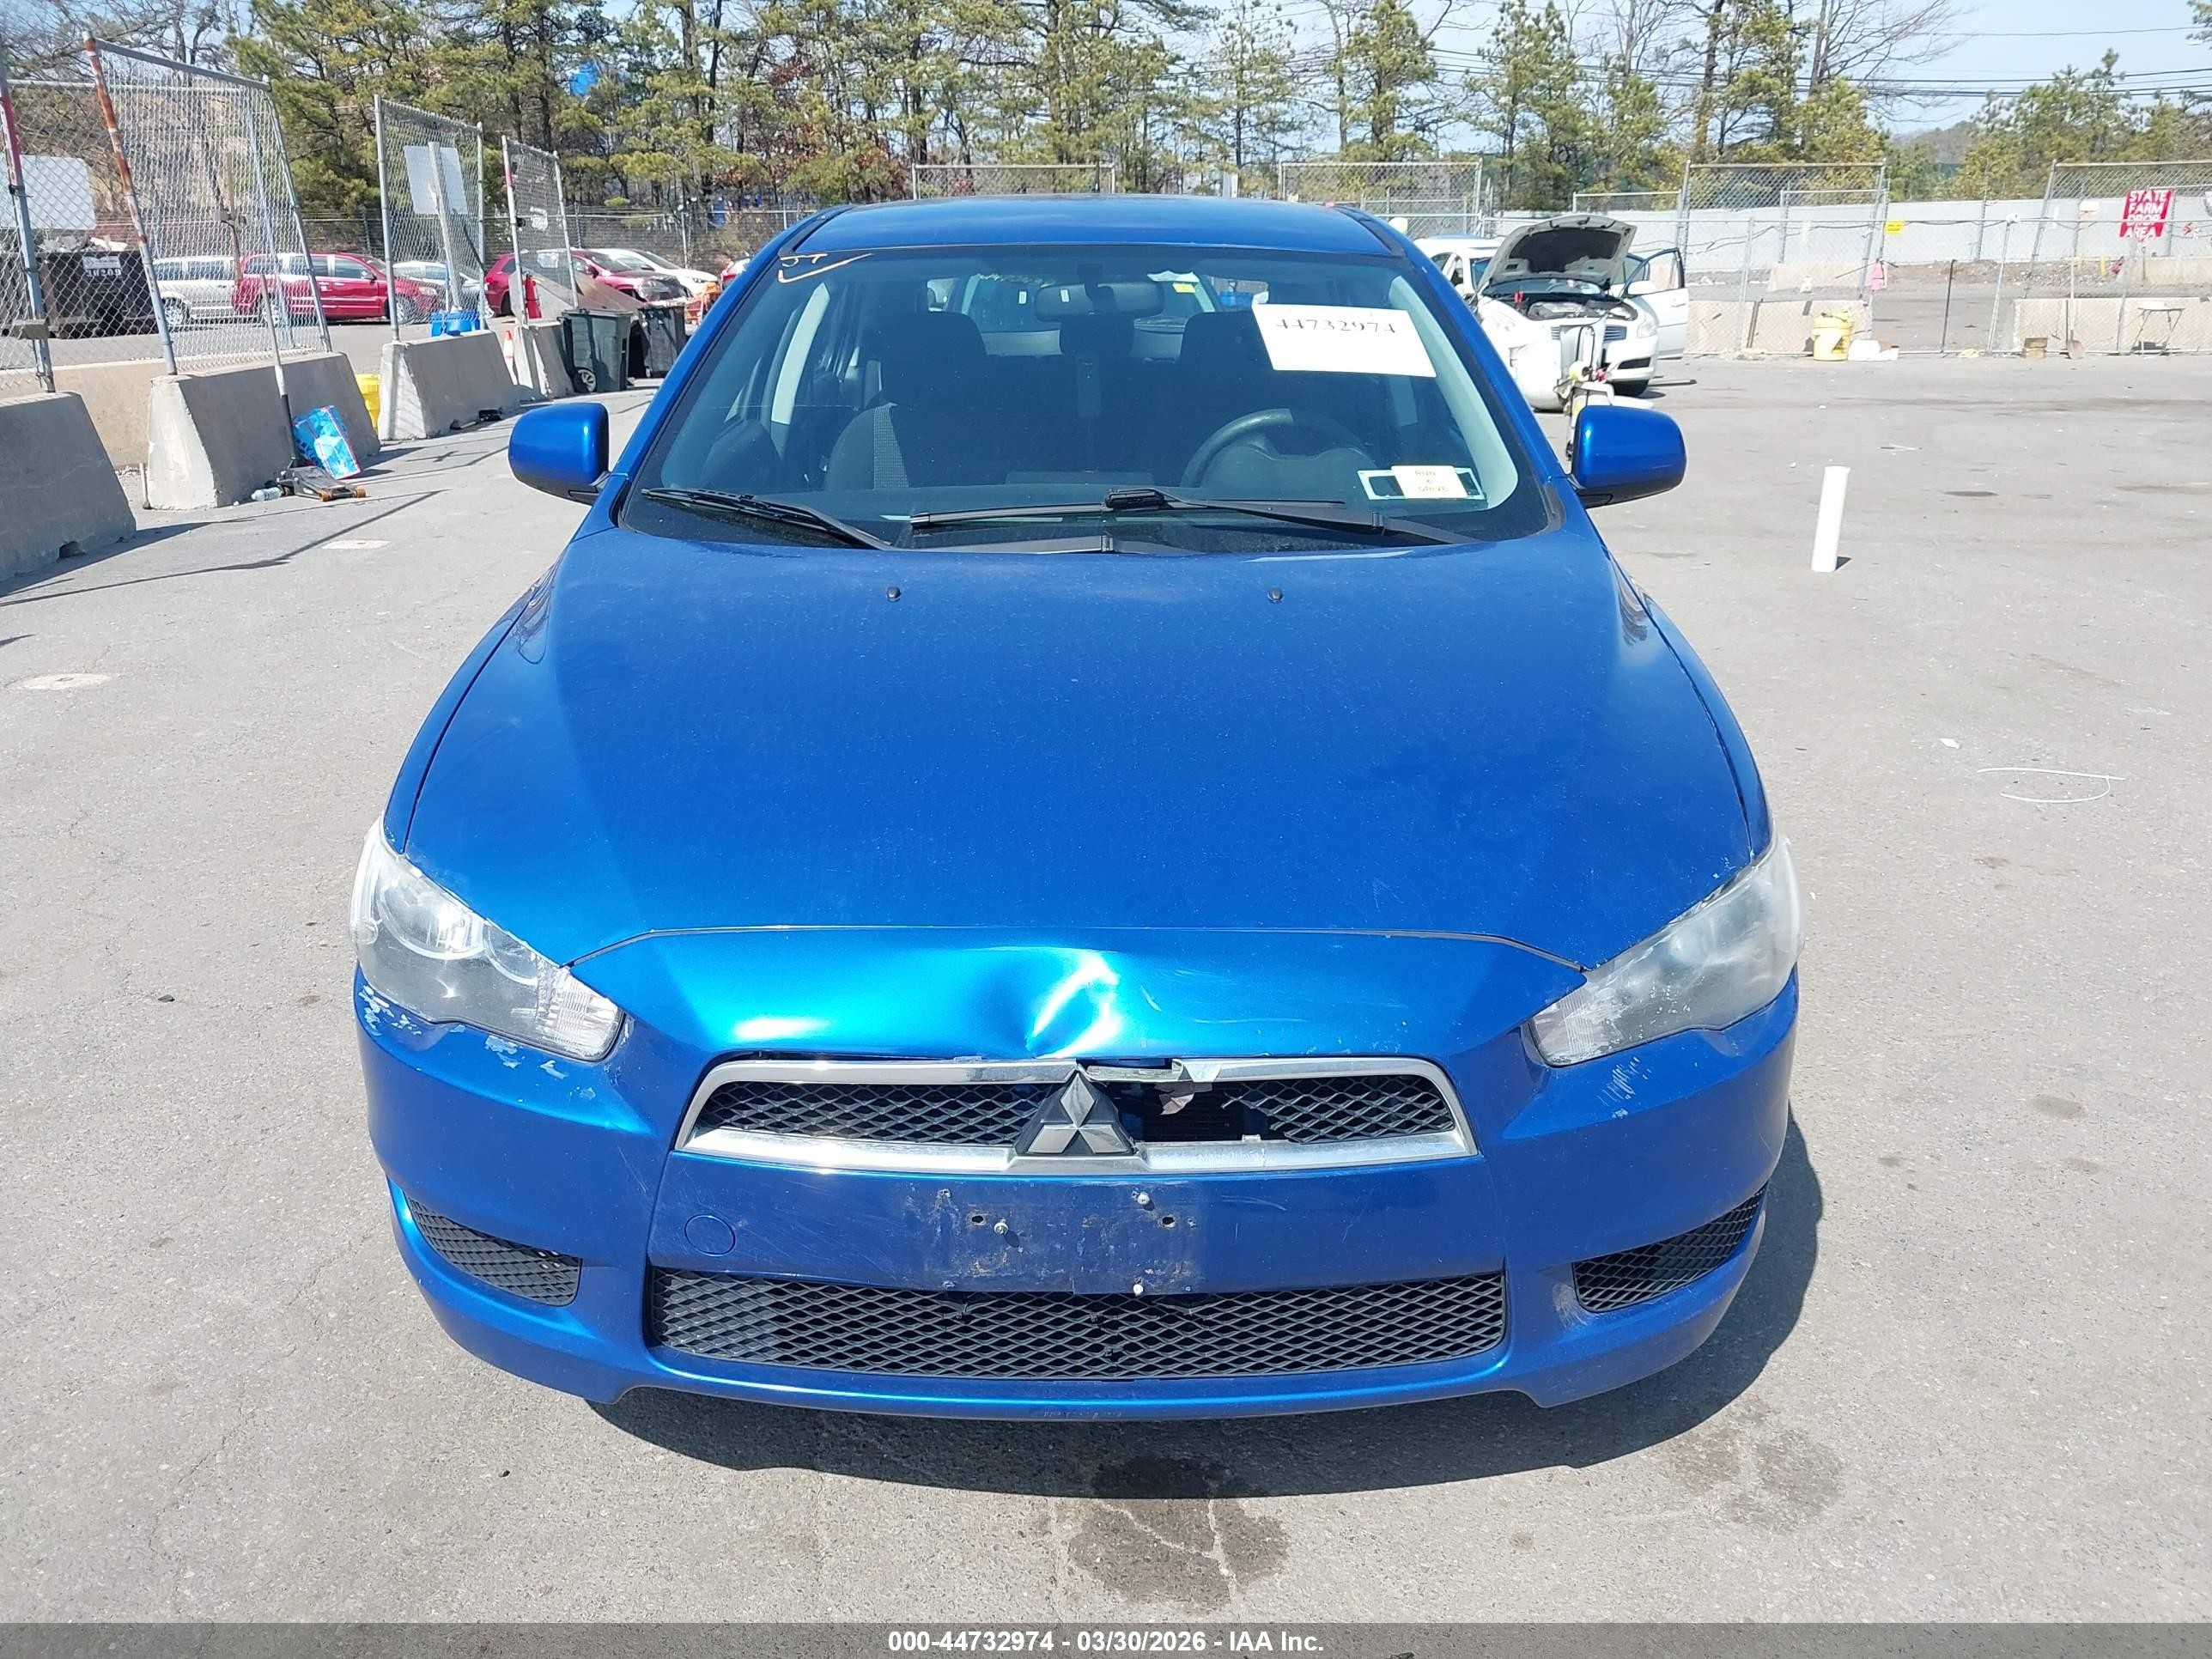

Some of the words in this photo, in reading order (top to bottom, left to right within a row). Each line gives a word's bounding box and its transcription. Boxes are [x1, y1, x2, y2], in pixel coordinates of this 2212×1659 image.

[2129, 190, 2167, 203] STATE
[2129, 202, 2162, 215] FARM
[2126, 214, 2160, 226] DROP
[2124, 226, 2157, 240] AREA
